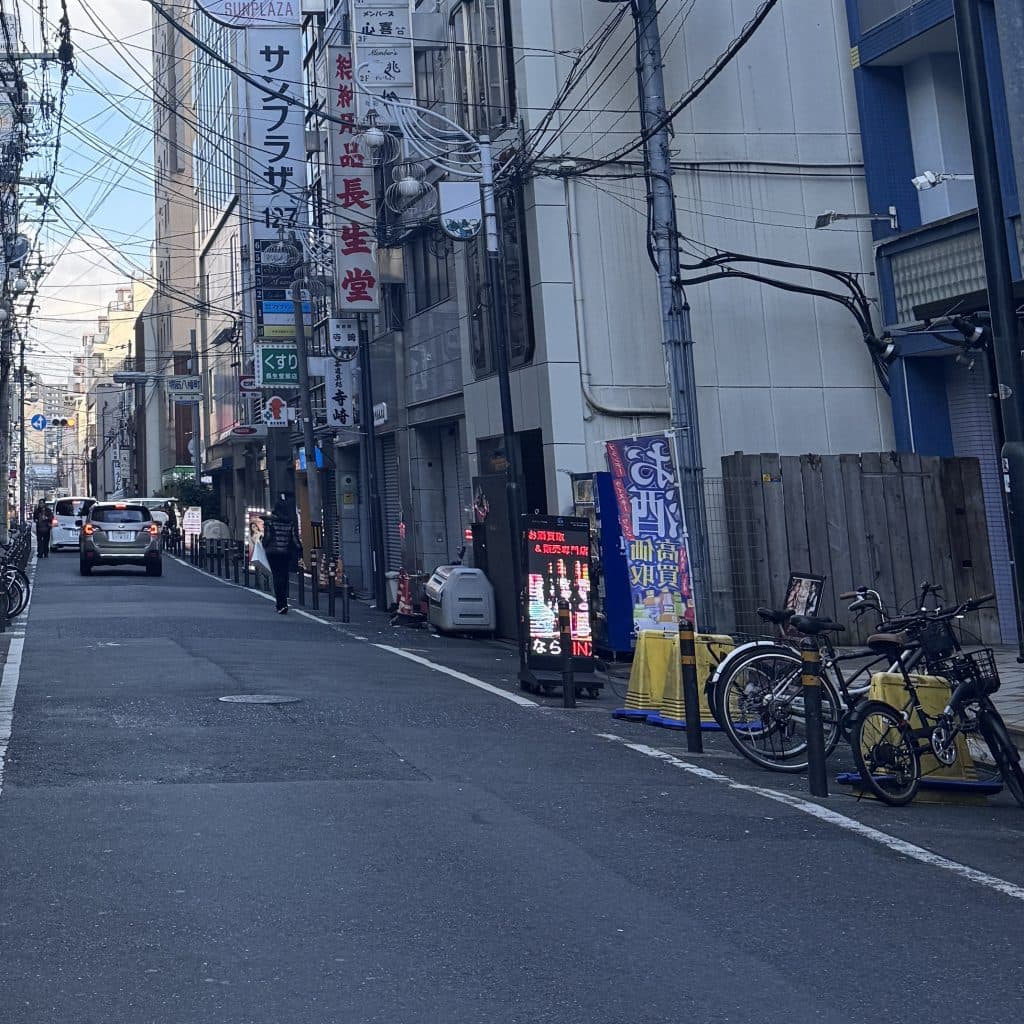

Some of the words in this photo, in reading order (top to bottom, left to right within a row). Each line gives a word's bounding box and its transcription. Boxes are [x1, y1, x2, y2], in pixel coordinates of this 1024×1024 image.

[264, 353, 298, 370] くすり
[532, 638, 562, 655] なら
